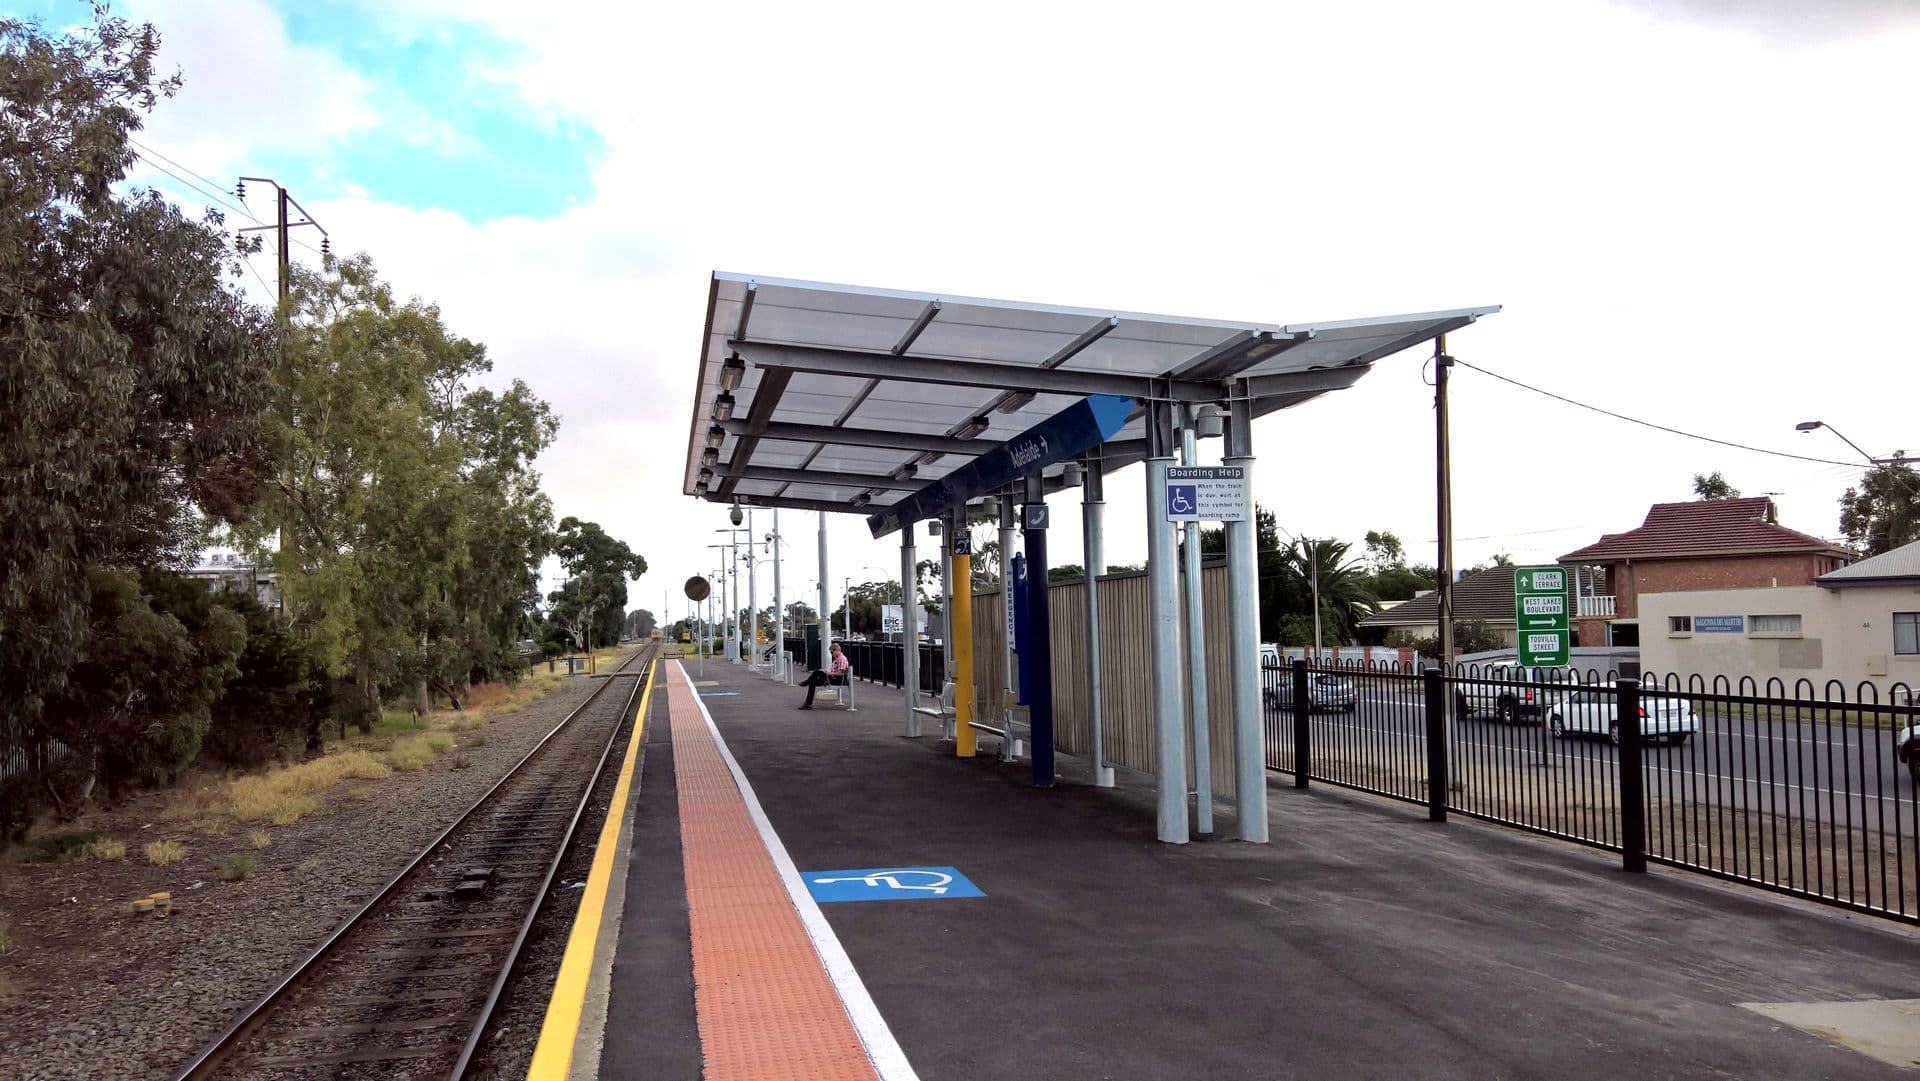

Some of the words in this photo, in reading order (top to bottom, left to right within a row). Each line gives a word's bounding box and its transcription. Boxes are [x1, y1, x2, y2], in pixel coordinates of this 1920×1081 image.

[1010, 440, 1041, 468] Adelaide
[1170, 468, 1213, 478] Boarding
[1219, 468, 1241, 478] Help
